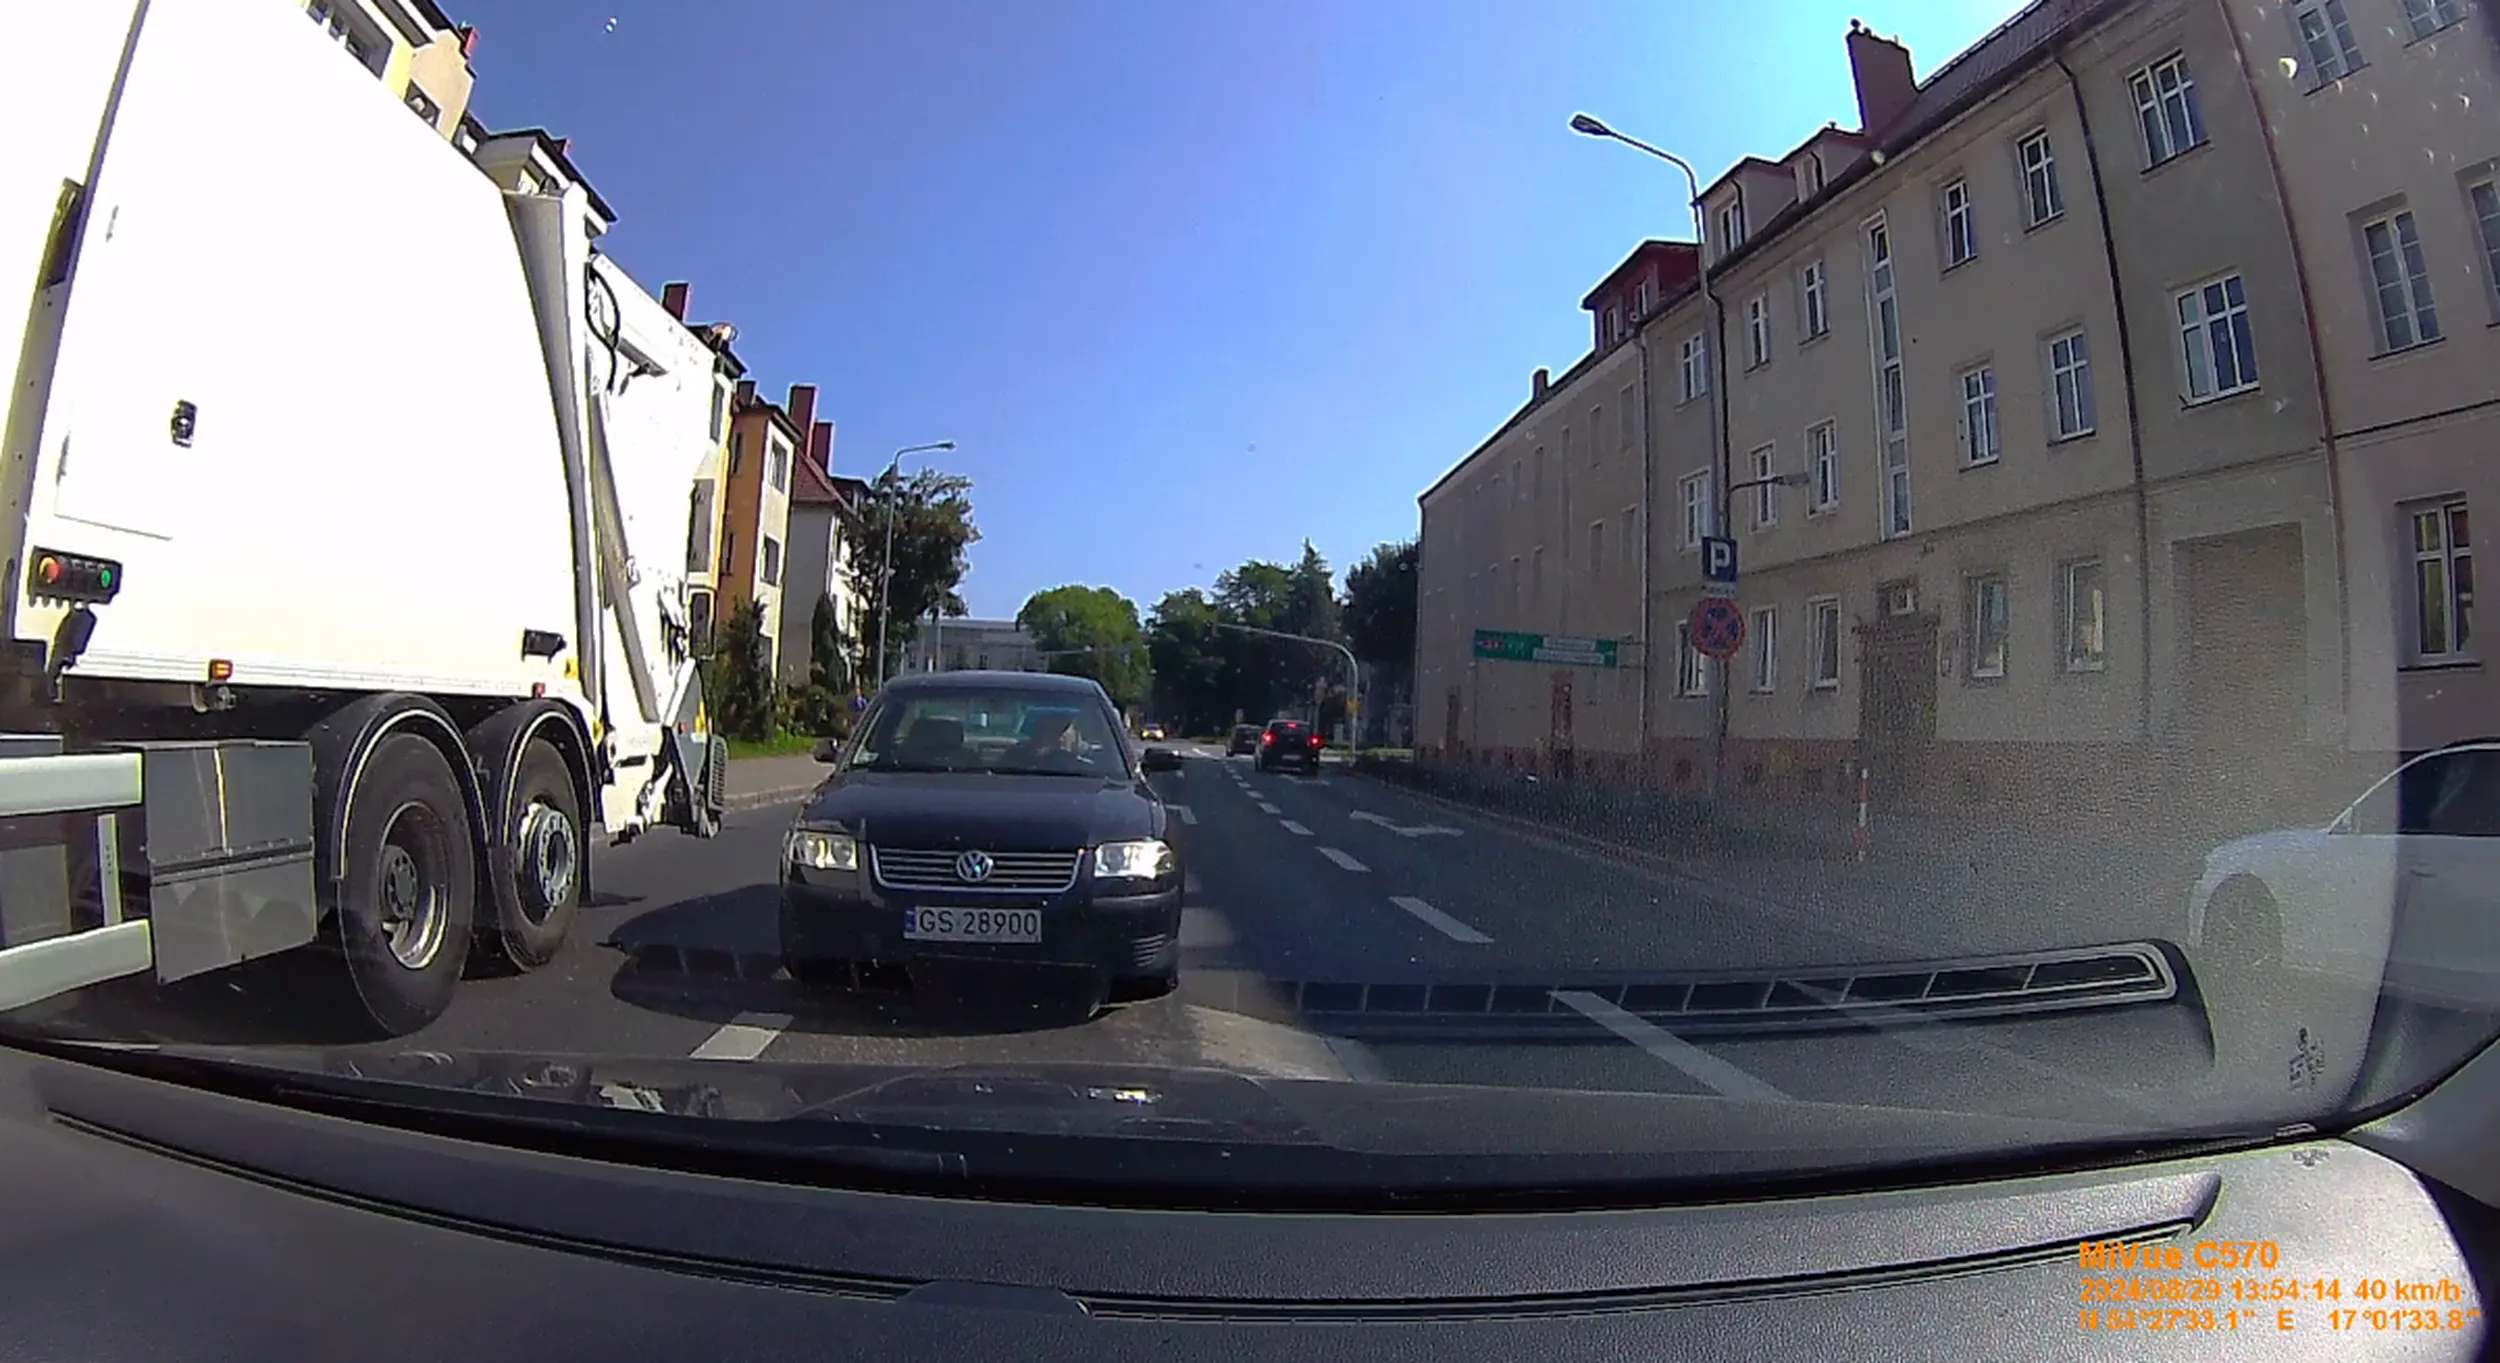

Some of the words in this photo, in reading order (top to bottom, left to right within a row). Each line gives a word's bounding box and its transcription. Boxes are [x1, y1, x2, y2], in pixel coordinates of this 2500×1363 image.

[1709, 541, 1730, 575] P
[919, 909, 953, 933] GS
[963, 911, 1038, 935] 28900
